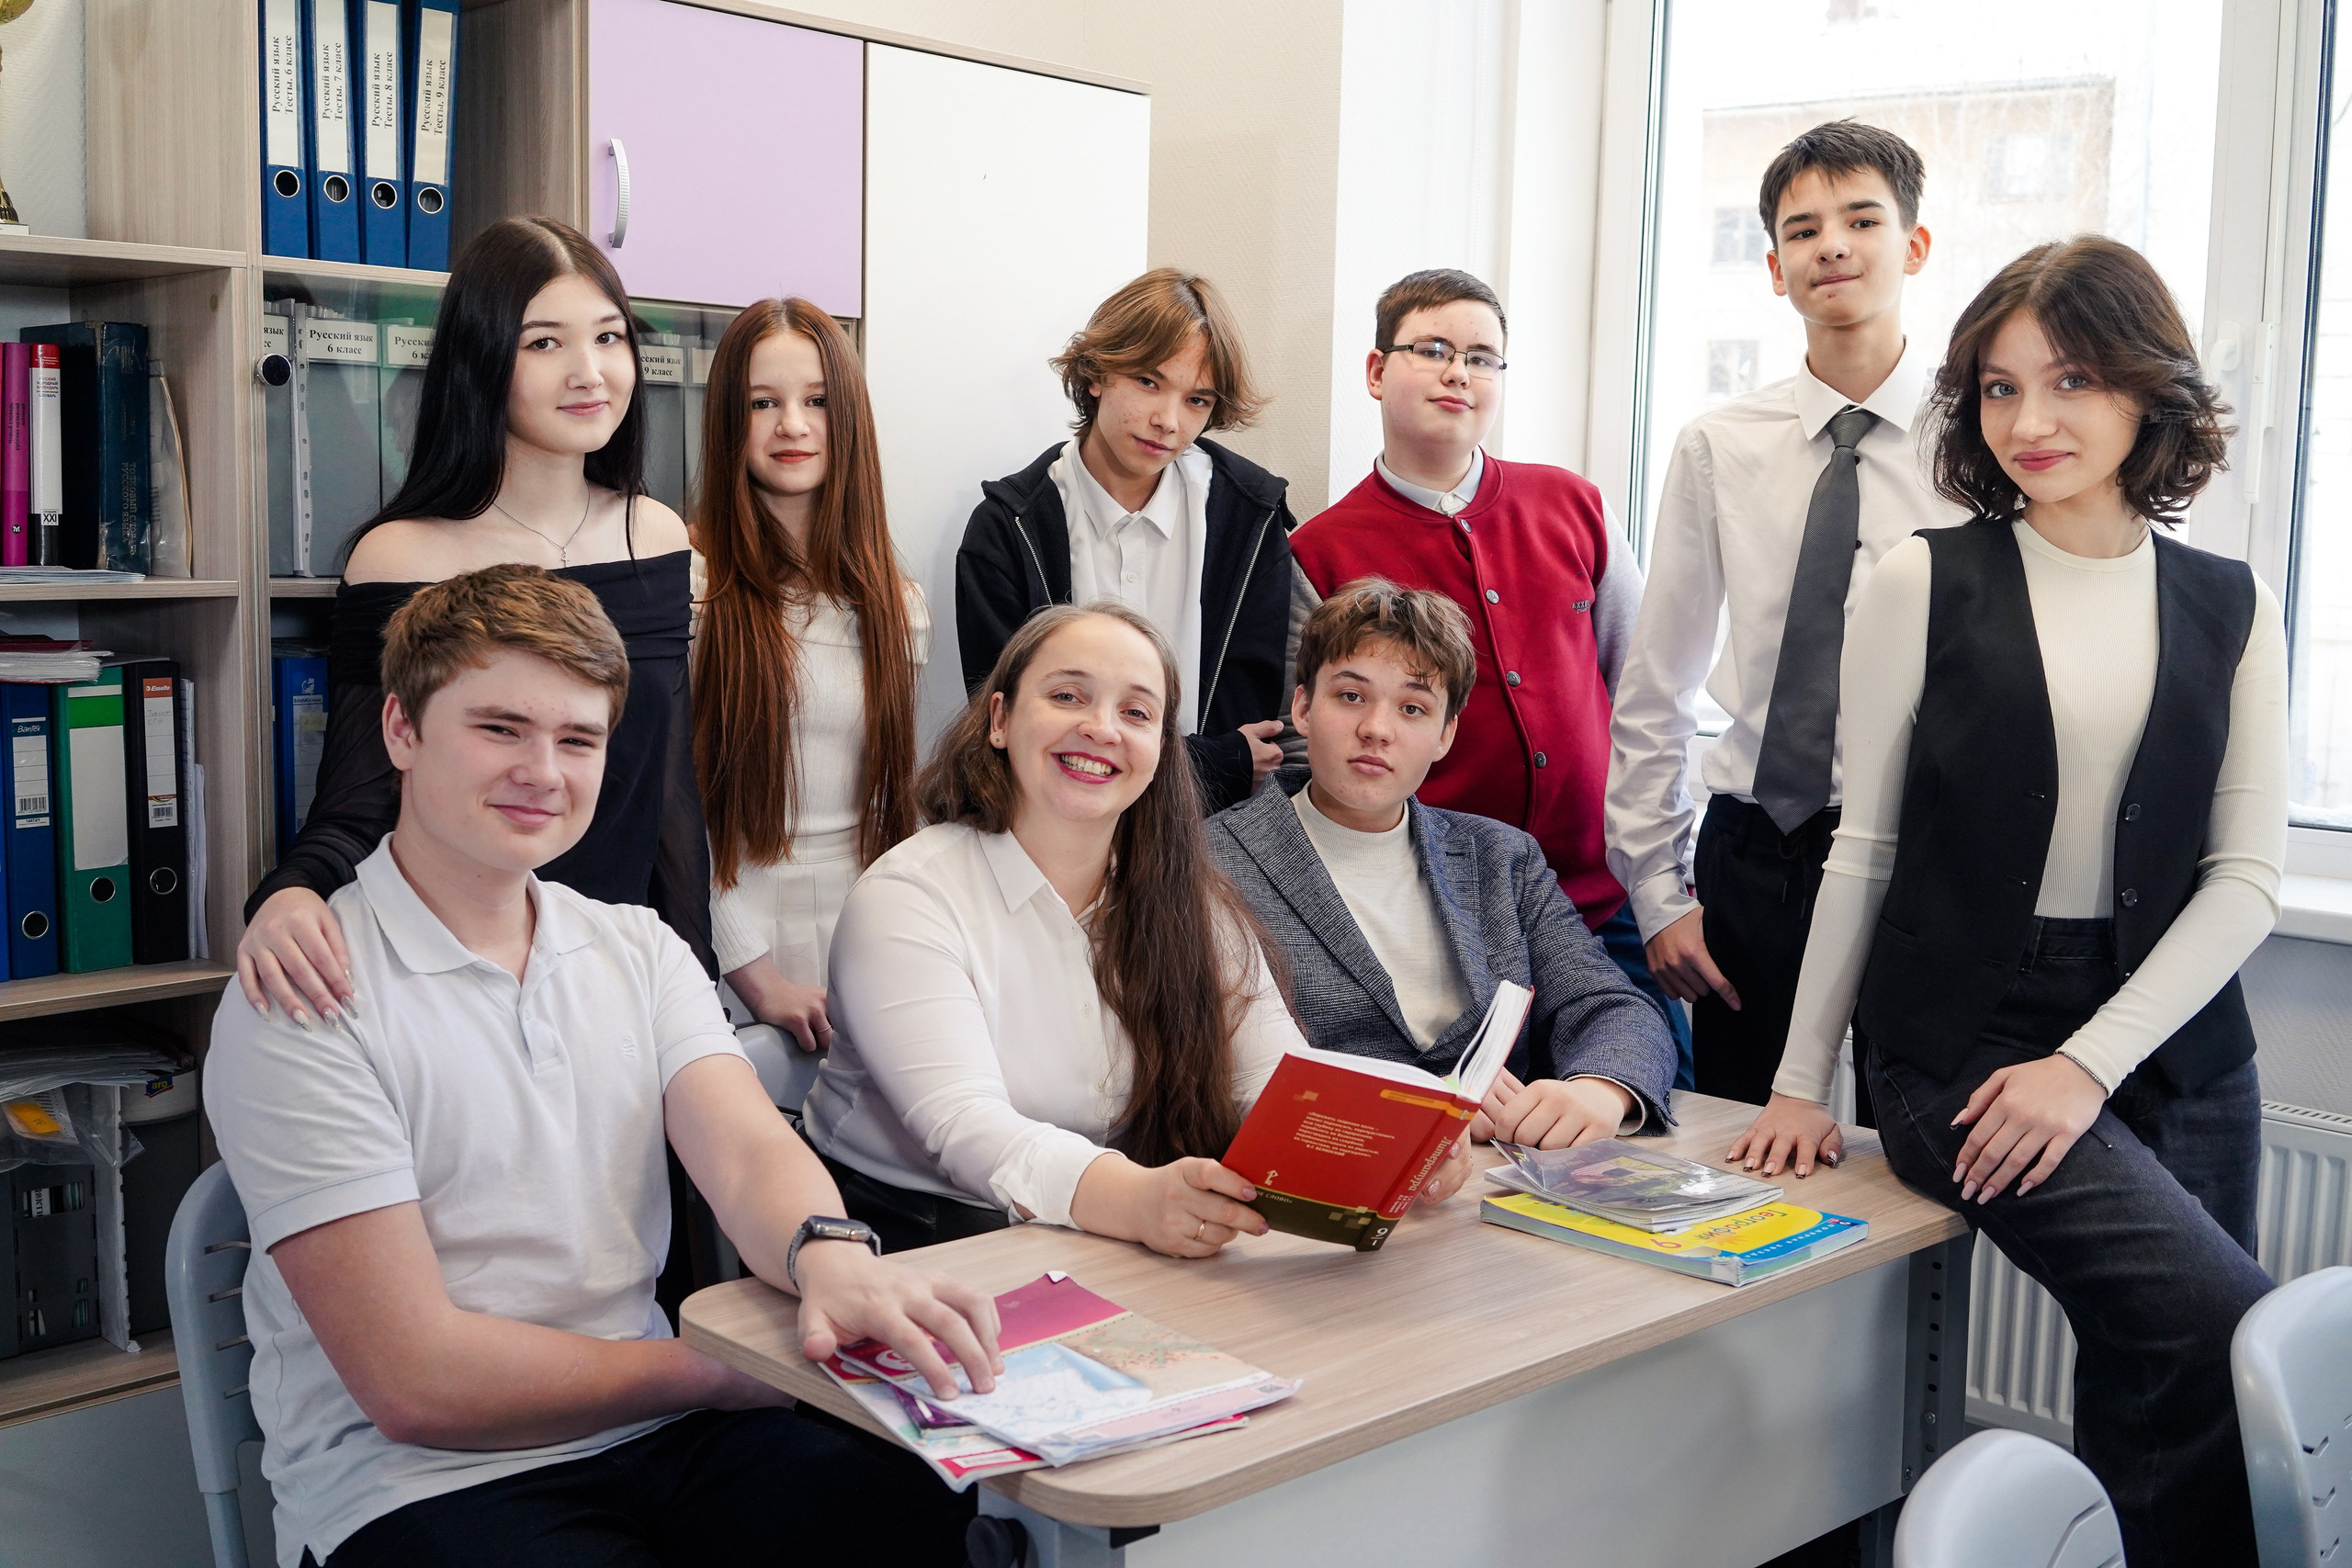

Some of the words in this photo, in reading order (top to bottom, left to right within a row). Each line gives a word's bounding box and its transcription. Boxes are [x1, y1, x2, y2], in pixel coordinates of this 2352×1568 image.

[438, 60, 447, 89] класс
[272, 68, 282, 113] Русский
[285, 78, 293, 115] Тесты.
[322, 75, 333, 119] Русский
[334, 85, 343, 121] Тесты.
[371, 84, 382, 127] Русский
[384, 94, 392, 130] Тесты.
[421, 89, 432, 132] Русский
[434, 101, 444, 136] Тесты.
[263, 327, 285, 335] язык
[310, 329, 352, 341] Русский
[354, 334, 374, 343] язык
[327, 344, 334, 353] 6
[336, 345, 362, 355] класс
[412, 350, 418, 359] 6
[640, 355, 664, 364] сский
[43, 513, 57, 522] XXI
[17, 725, 40, 733] Bantex
[152, 1080, 168, 1089] aro
[1408, 1136, 1453, 1191] Литература
[1374, 1227, 1388, 1236] 9
[1694, 1209, 1788, 1240] География
[1785, 1224, 1835, 1244] ПОЛЯРНАЯ
